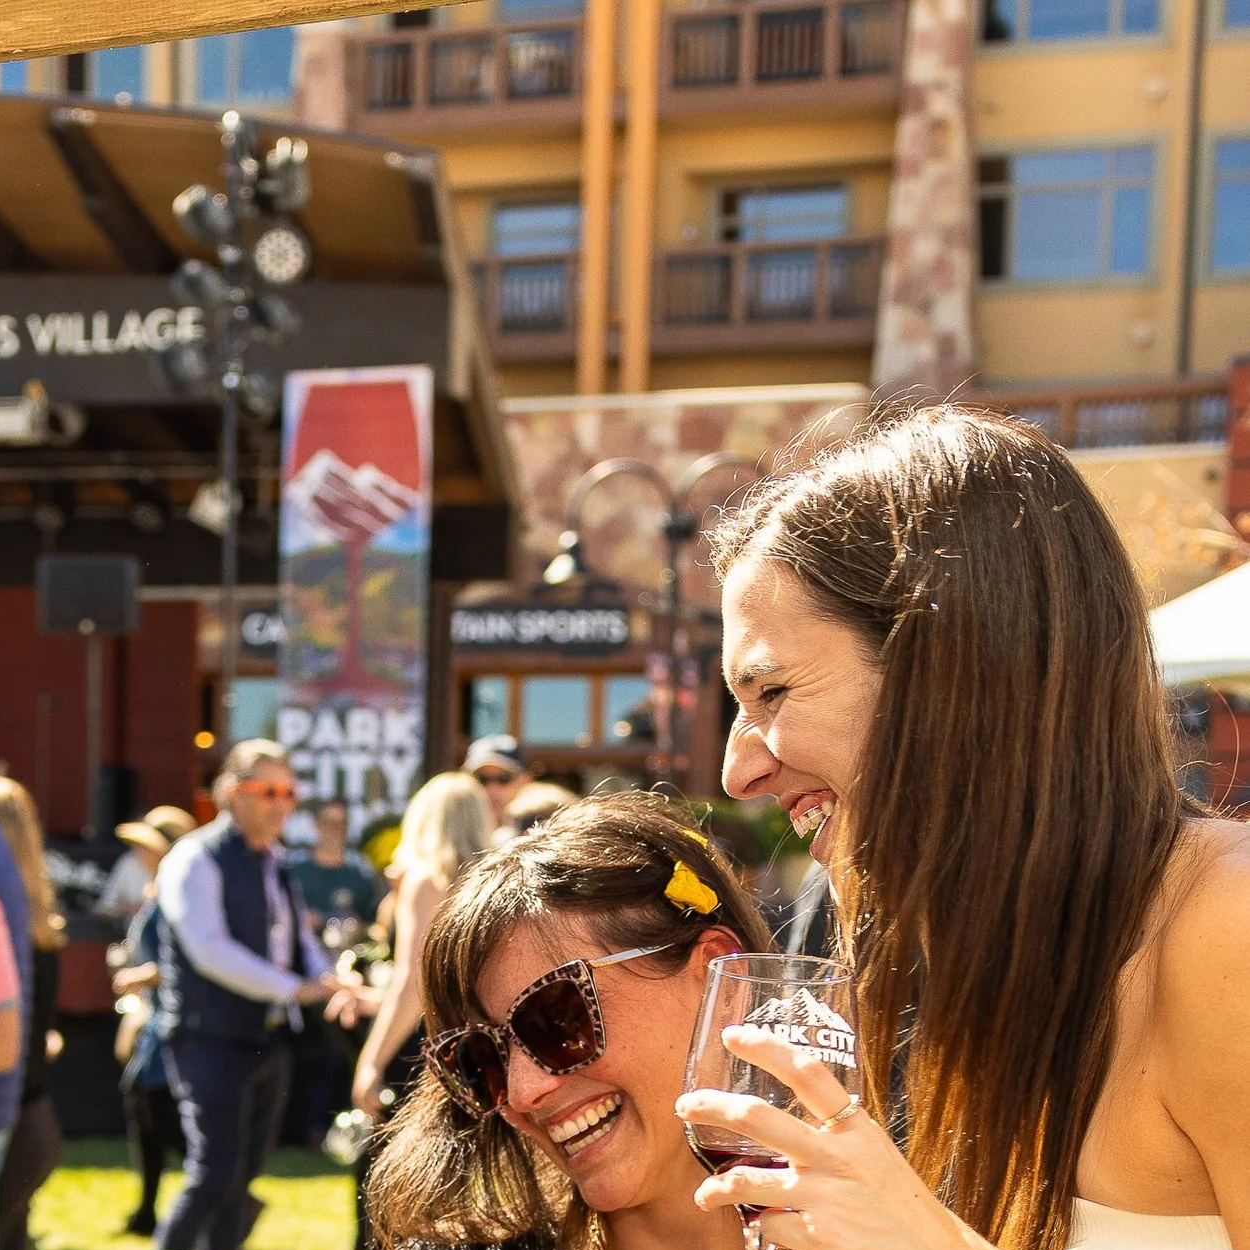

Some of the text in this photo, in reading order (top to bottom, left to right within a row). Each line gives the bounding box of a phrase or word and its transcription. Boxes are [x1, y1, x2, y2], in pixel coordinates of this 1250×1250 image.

[26, 305, 206, 356] VILLAGE
[513, 608, 629, 646] SPORTS
[277, 707, 422, 750] PARK
[816, 1028, 856, 1053] CITY
